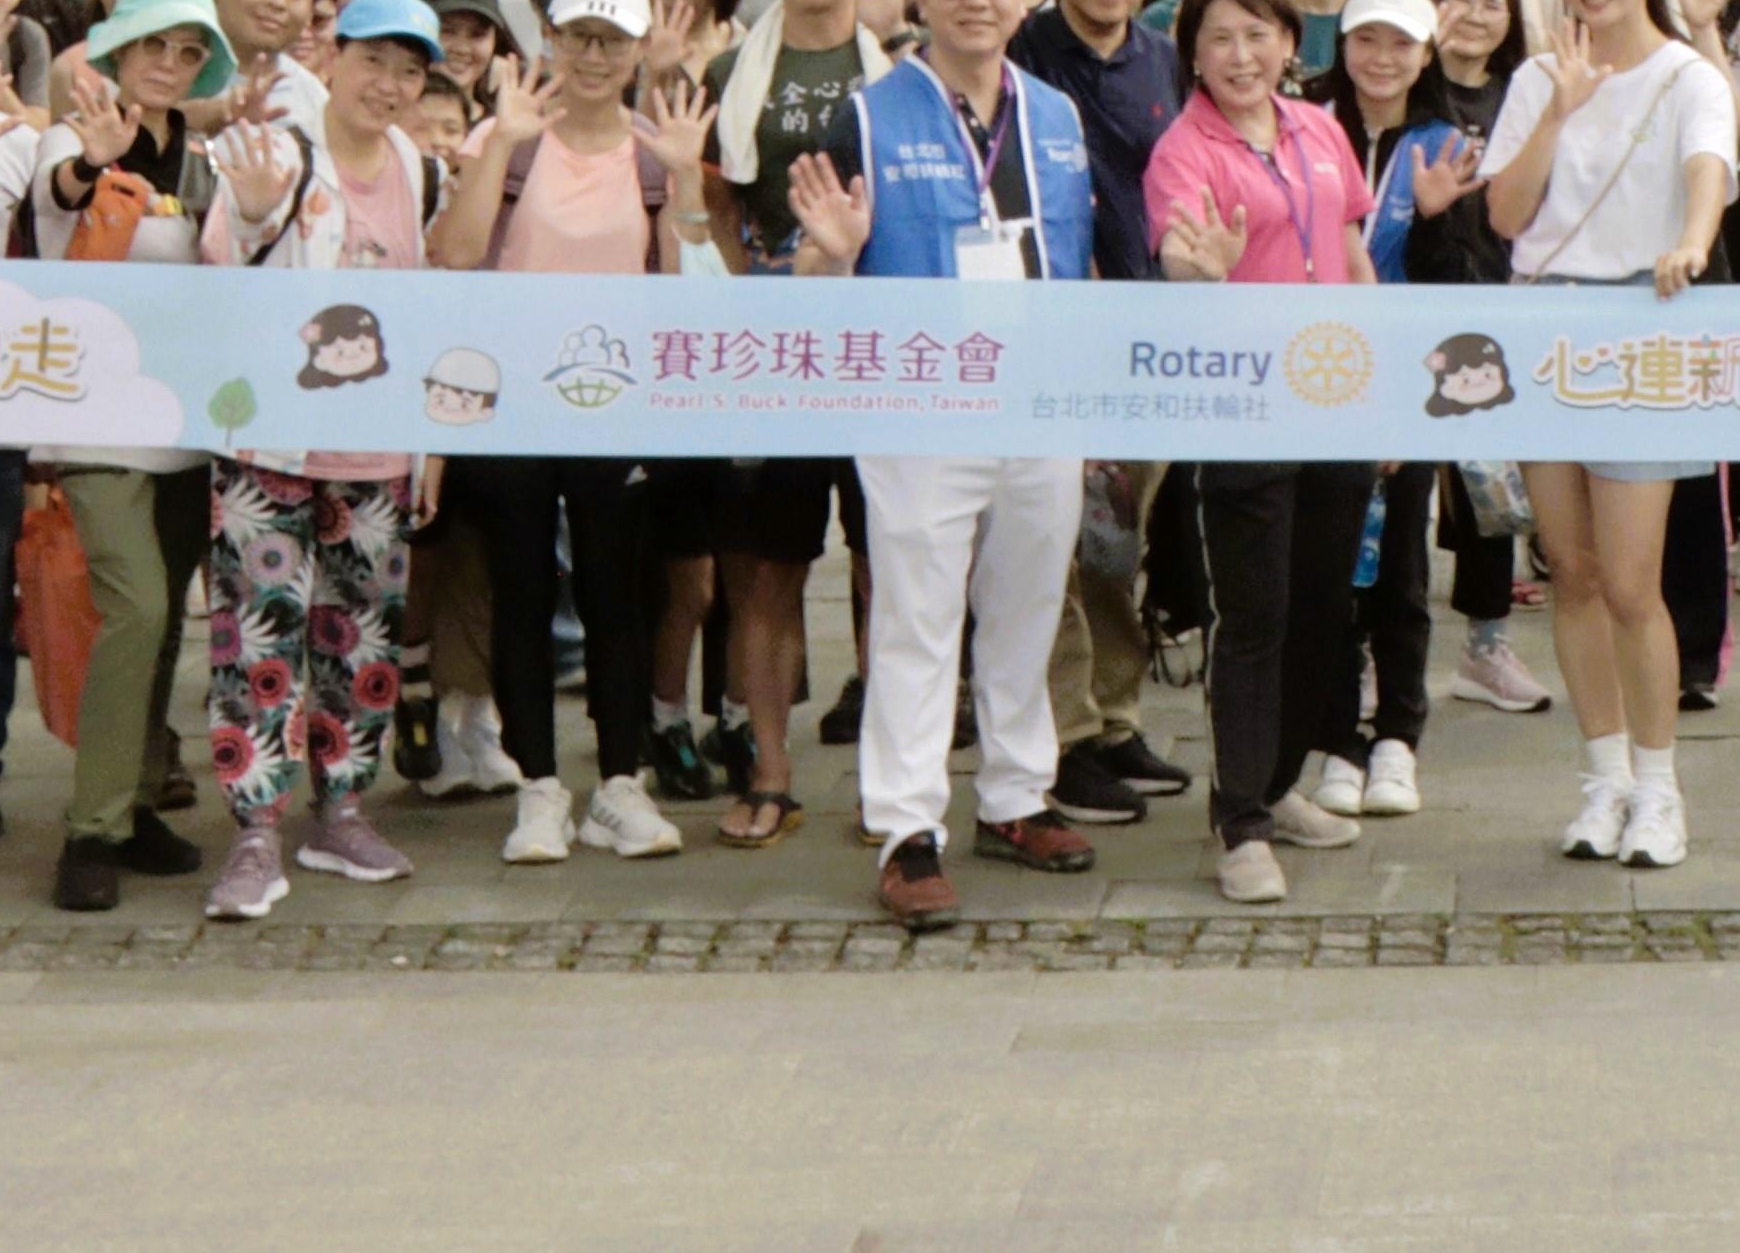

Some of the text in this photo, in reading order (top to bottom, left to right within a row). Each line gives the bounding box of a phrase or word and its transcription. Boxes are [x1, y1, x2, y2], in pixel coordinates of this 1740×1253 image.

[651, 328, 1006, 383] 賽珍珠基金會
[1129, 341, 1272, 386] Rotary
[650, 392, 703, 410] Pearl
[738, 392, 788, 409] Buck
[798, 391, 925, 412] Foundation,
[931, 391, 999, 410] Taiwan
[1030, 392, 1272, 421] 台北市安和扶輪社
